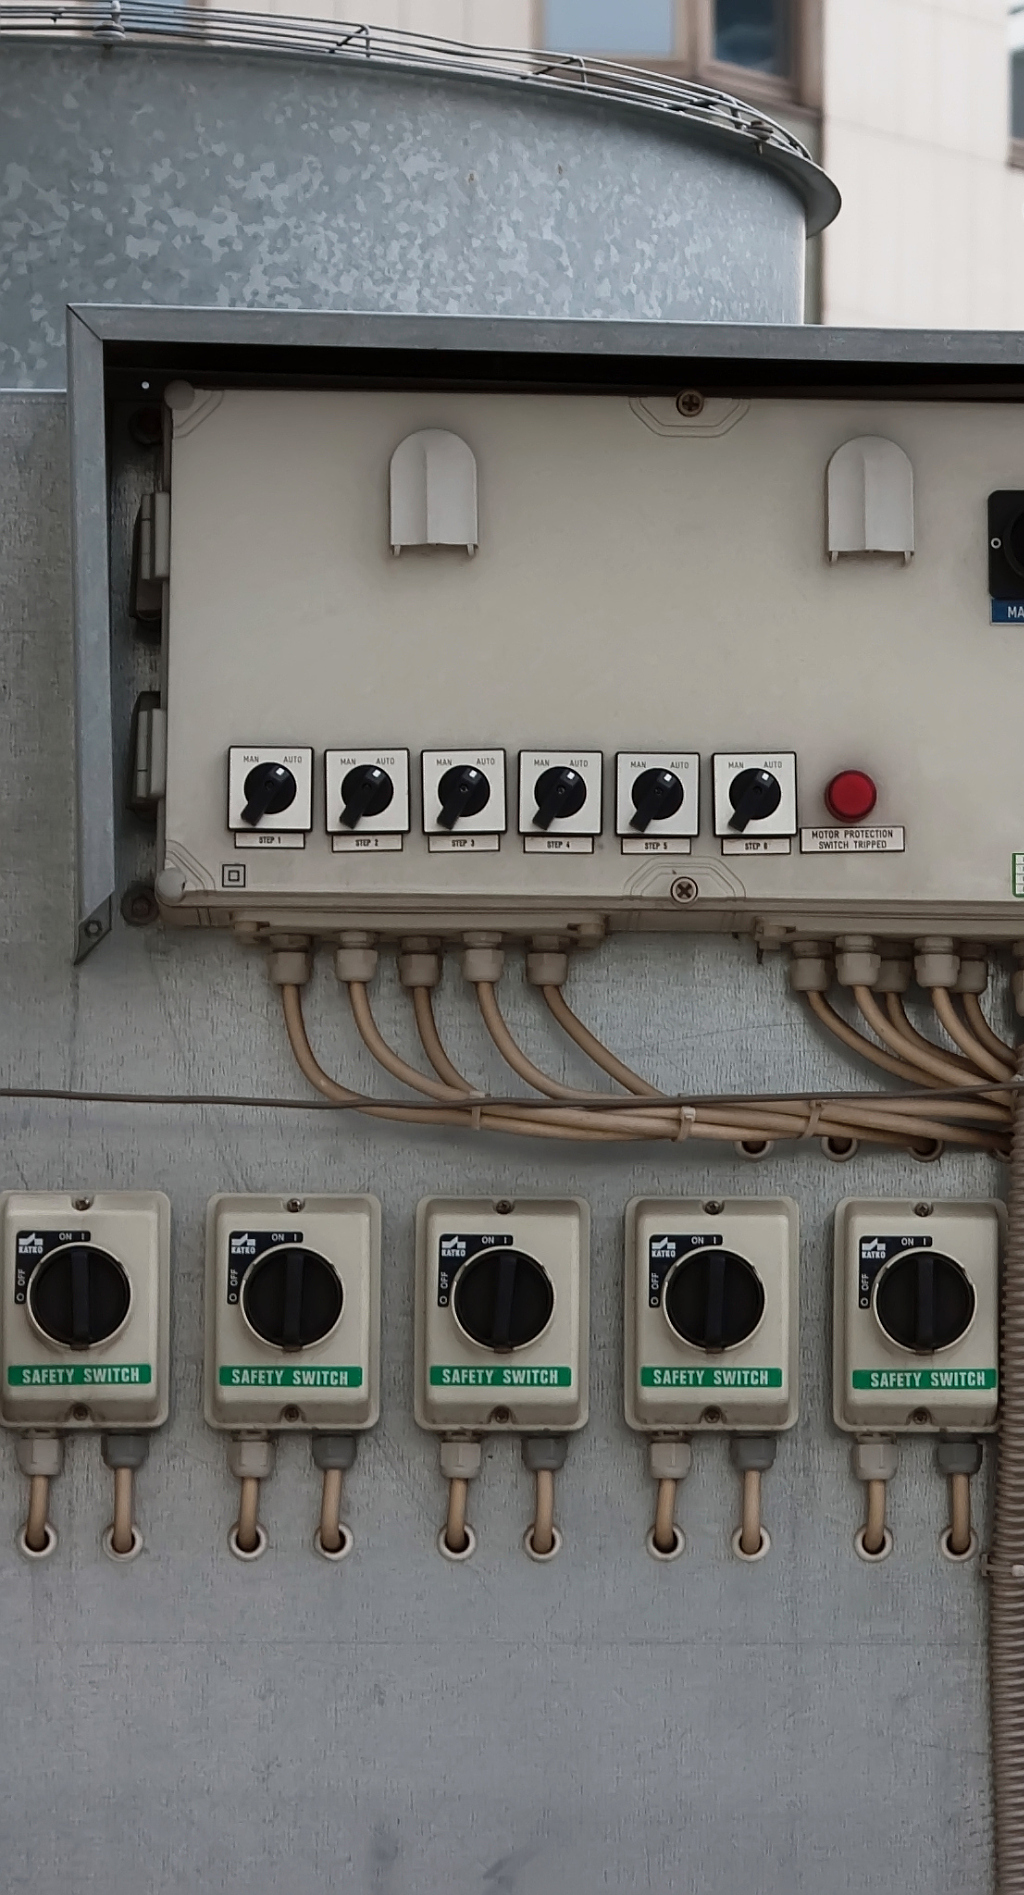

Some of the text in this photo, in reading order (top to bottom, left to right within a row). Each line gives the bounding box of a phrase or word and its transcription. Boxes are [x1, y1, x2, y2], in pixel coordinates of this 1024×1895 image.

[243, 755, 303, 764] MAN AUTO
[340, 757, 395, 766] MAN AUTO
[436, 758, 496, 766] MAN AUTO
[533, 759, 589, 767] MAN AUTO
[629, 761, 690, 769] MAN AUTO
[728, 761, 783, 769] MAN AUTO
[811, 830, 894, 839] MOTOR PROTECTION
[258, 836, 275, 844] STEP
[355, 839, 372, 847] STEP
[451, 839, 468, 847] STEP
[546, 840, 563, 849] STEP
[644, 841, 660, 850] STEP
[744, 842, 760, 850] STEP
[818, 840, 888, 850] SWITCH TRIPPED
[58, 1233, 73, 1241] ON
[271, 1233, 285, 1241] ON
[481, 1236, 495, 1245] ON
[691, 1236, 704, 1245] ON
[901, 1238, 914, 1246] ON
[18, 1246, 44, 1254] KATKO
[231, 1246, 256, 1254] KATKO
[441, 1249, 466, 1257] KATKO
[651, 1249, 676, 1258] KATKO
[861, 1251, 886, 1259] KATKO
[18, 1268, 26, 1287] OFF
[230, 1268, 238, 1287] OFF
[440, 1271, 448, 1289] OFF
[651, 1272, 659, 1290] OFF
[861, 1273, 869, 1291] OFF
[22, 1367, 140, 1385] SAFETY SWITCH
[231, 1368, 349, 1386] SAFETY SWITCH
[442, 1369, 559, 1385] SAFETY SWITCH
[653, 1369, 769, 1386] SAFETY SWITCH
[870, 1371, 986, 1388] SAFETY SWITCH
